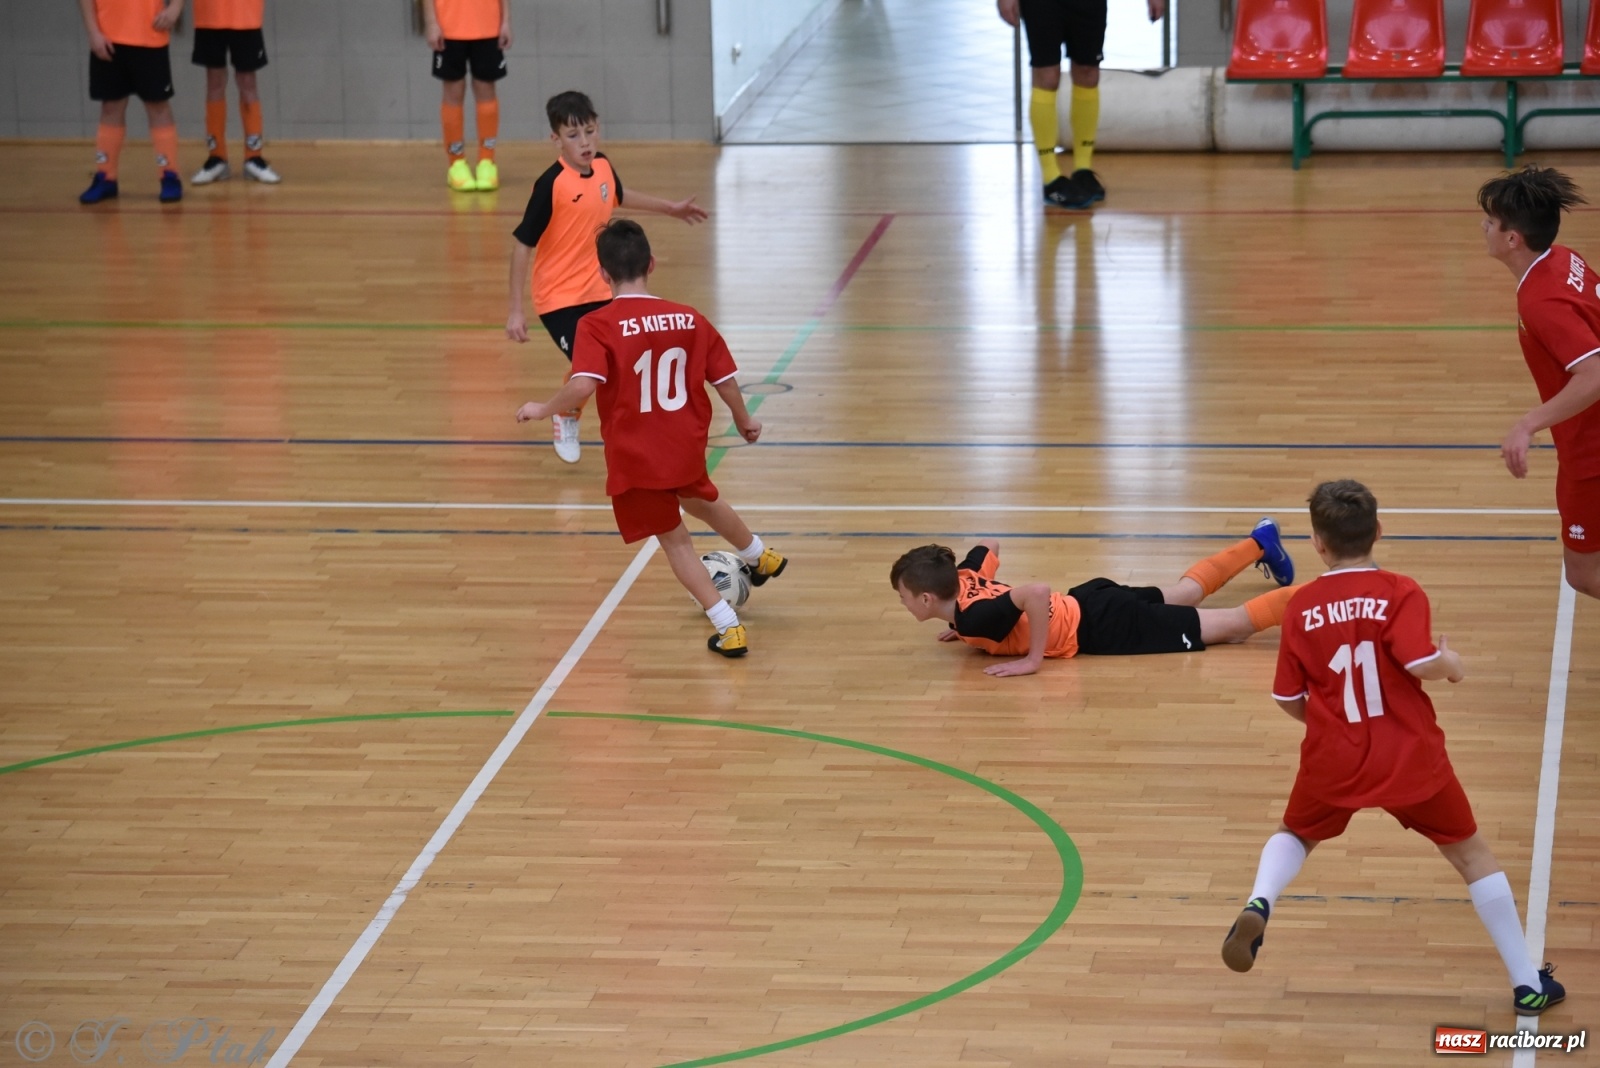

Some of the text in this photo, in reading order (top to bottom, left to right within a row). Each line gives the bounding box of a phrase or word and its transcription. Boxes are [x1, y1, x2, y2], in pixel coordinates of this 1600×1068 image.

[1566, 272, 1585, 293] ZS
[618, 313, 696, 337] ZS KIETRZ
[633, 347, 688, 413] 10
[1302, 597, 1389, 632] ZS KIETRZ
[1328, 640, 1384, 723] 11
